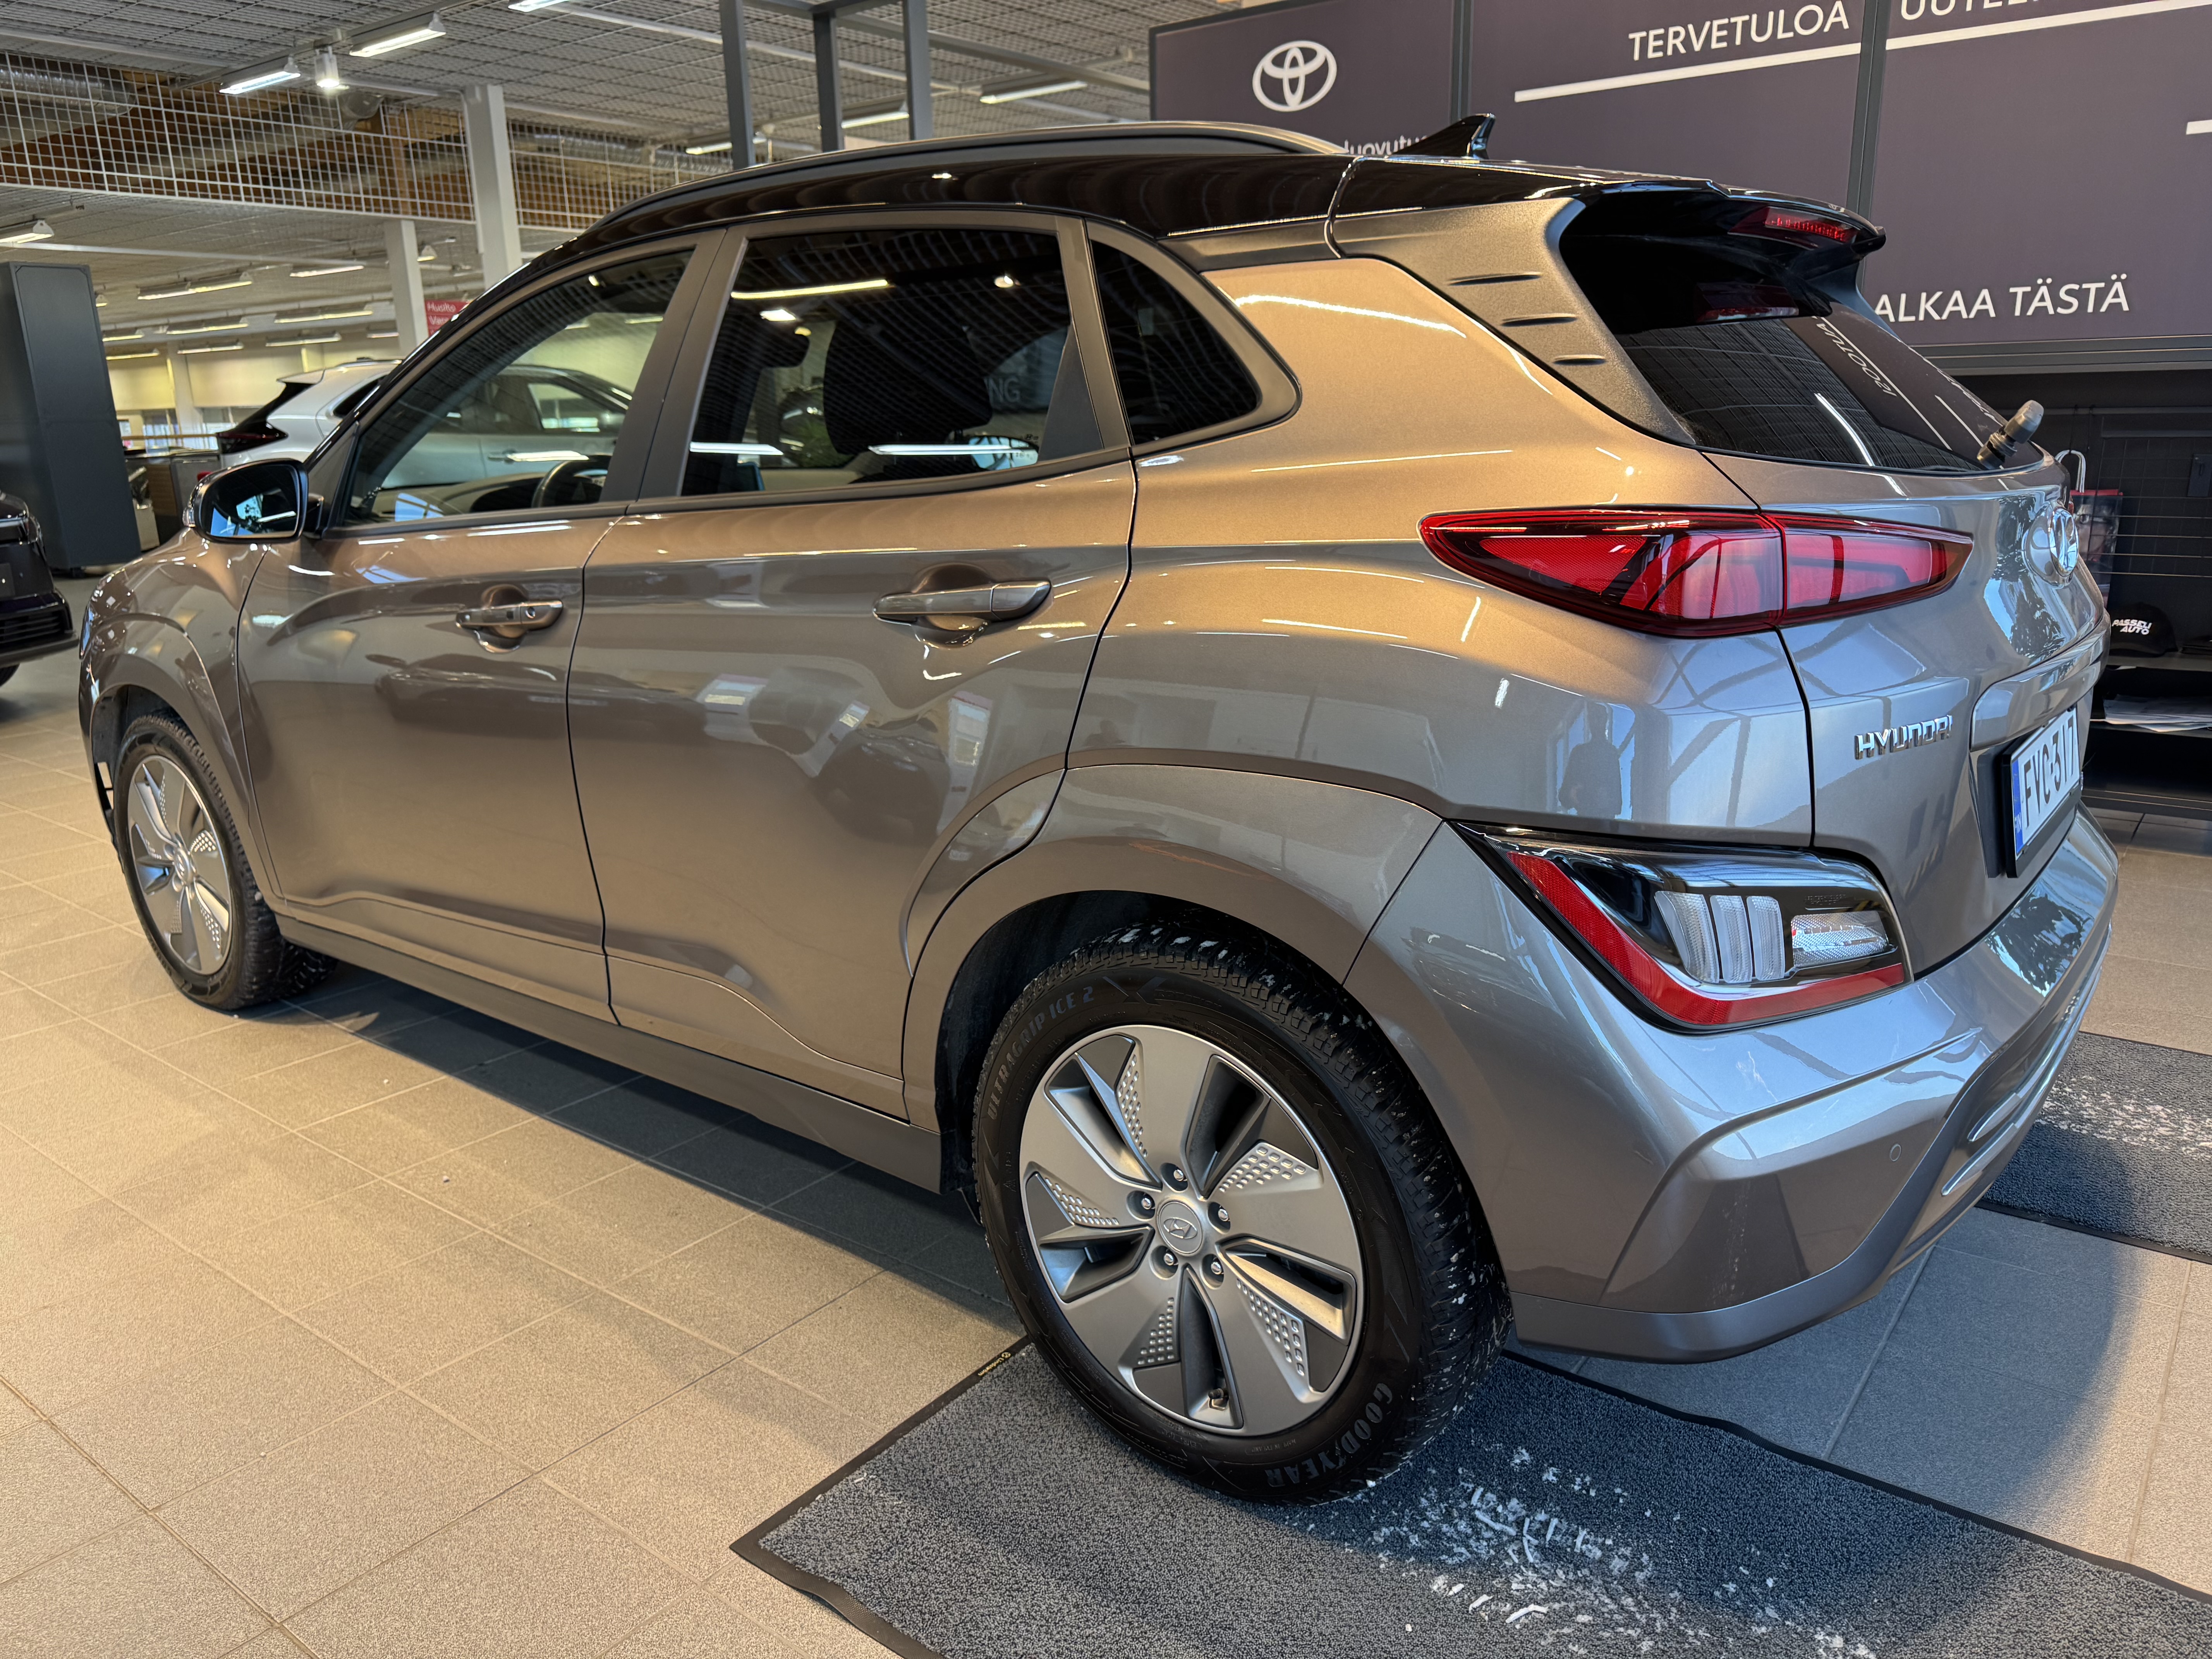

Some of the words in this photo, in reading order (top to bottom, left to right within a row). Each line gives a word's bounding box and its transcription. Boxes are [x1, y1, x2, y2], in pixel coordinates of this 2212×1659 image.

[1628, 0, 1850, 61] TERVETULOA
[1875, 288, 1996, 322] ALKAA
[2009, 273, 2130, 316] TÄSTÄ
[2112, 619, 2152, 629] PASSELI
[2120, 626, 2149, 635] AUTO
[1854, 714, 1953, 760] HYUNDAI
[2024, 715, 2074, 828] FVC-317
[987, 1012, 1045, 1120] ULTRAGRIP
[1049, 992, 1076, 1019] ICE
[1083, 986, 1094, 1003] 2
[1264, 1383, 1393, 1487] GOODYEAR
